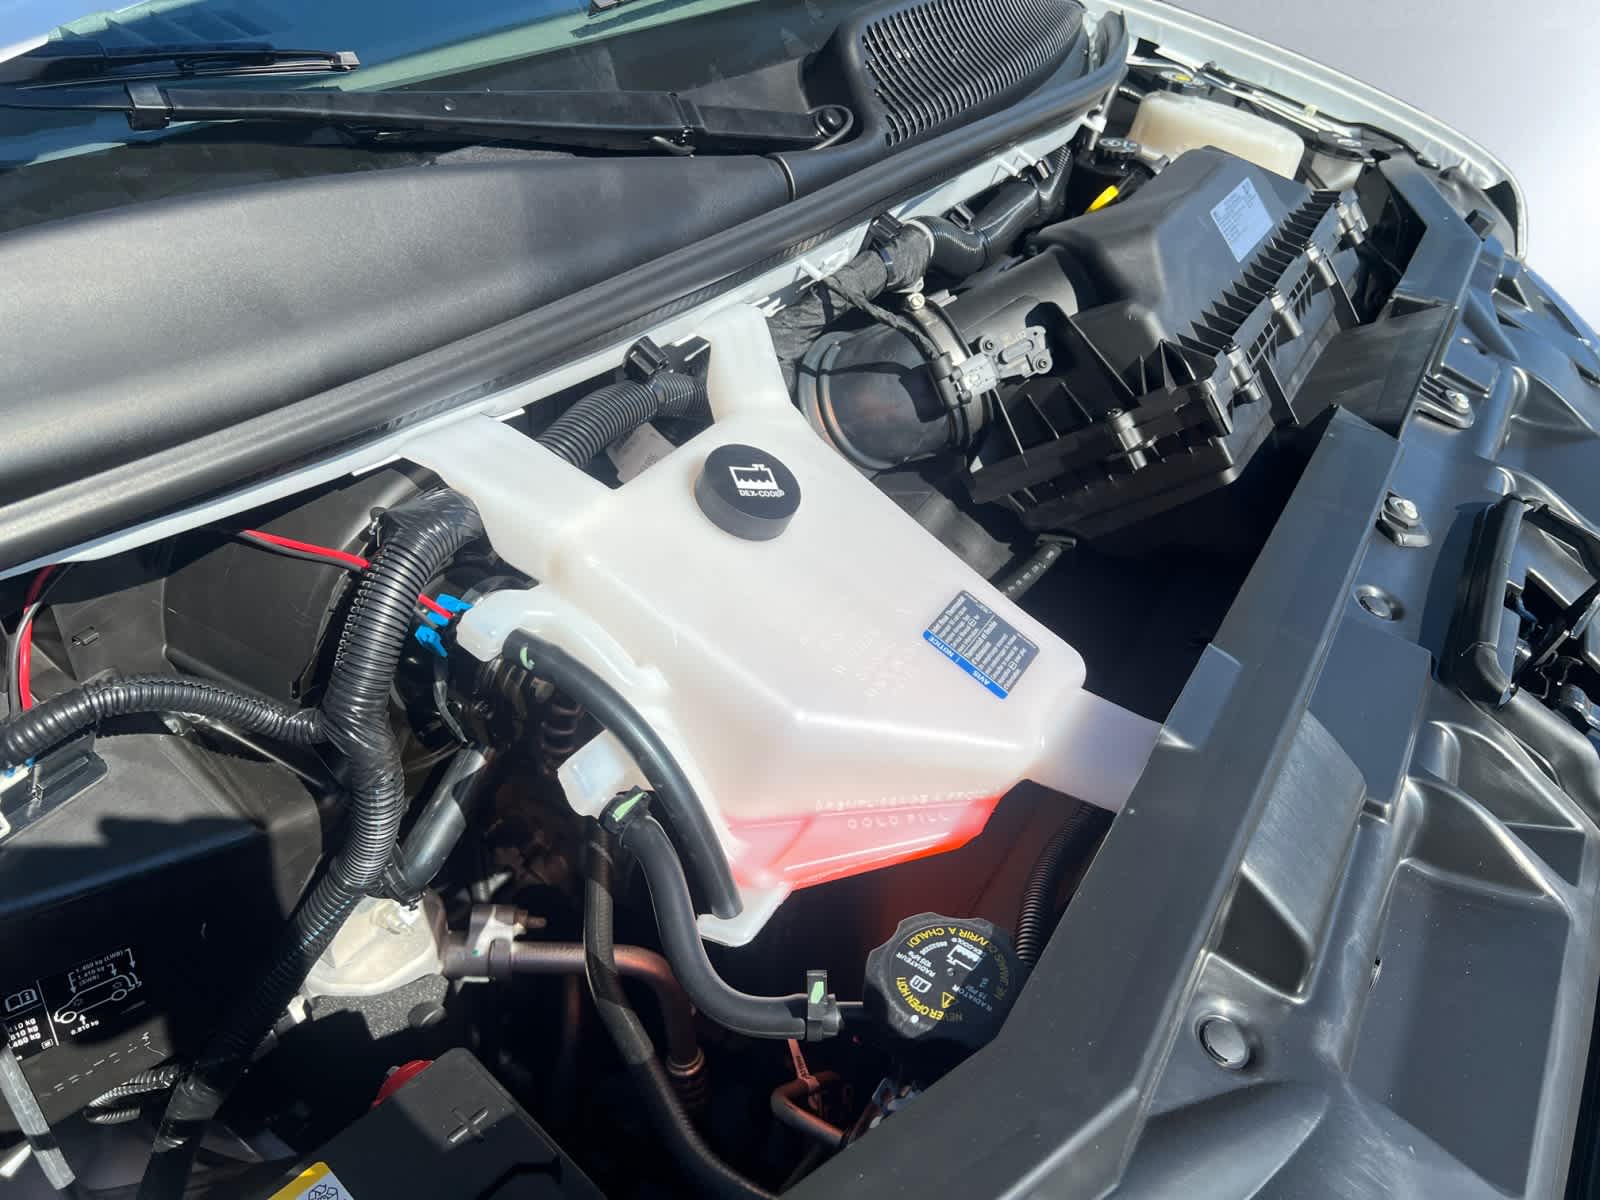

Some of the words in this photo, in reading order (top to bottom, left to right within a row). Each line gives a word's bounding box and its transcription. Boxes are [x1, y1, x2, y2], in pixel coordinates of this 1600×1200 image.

[930, 636, 955, 658] NOTICE
[971, 670, 990, 685] AVIS
[906, 927, 945, 948] CHAUD!
[896, 951, 936, 978] RADIATEUR
[896, 977, 910, 998] HOT!
[951, 984, 993, 1012] RADIATOR
[907, 994, 930, 1016] OPEN
[25, 1018, 36, 1026] kg
